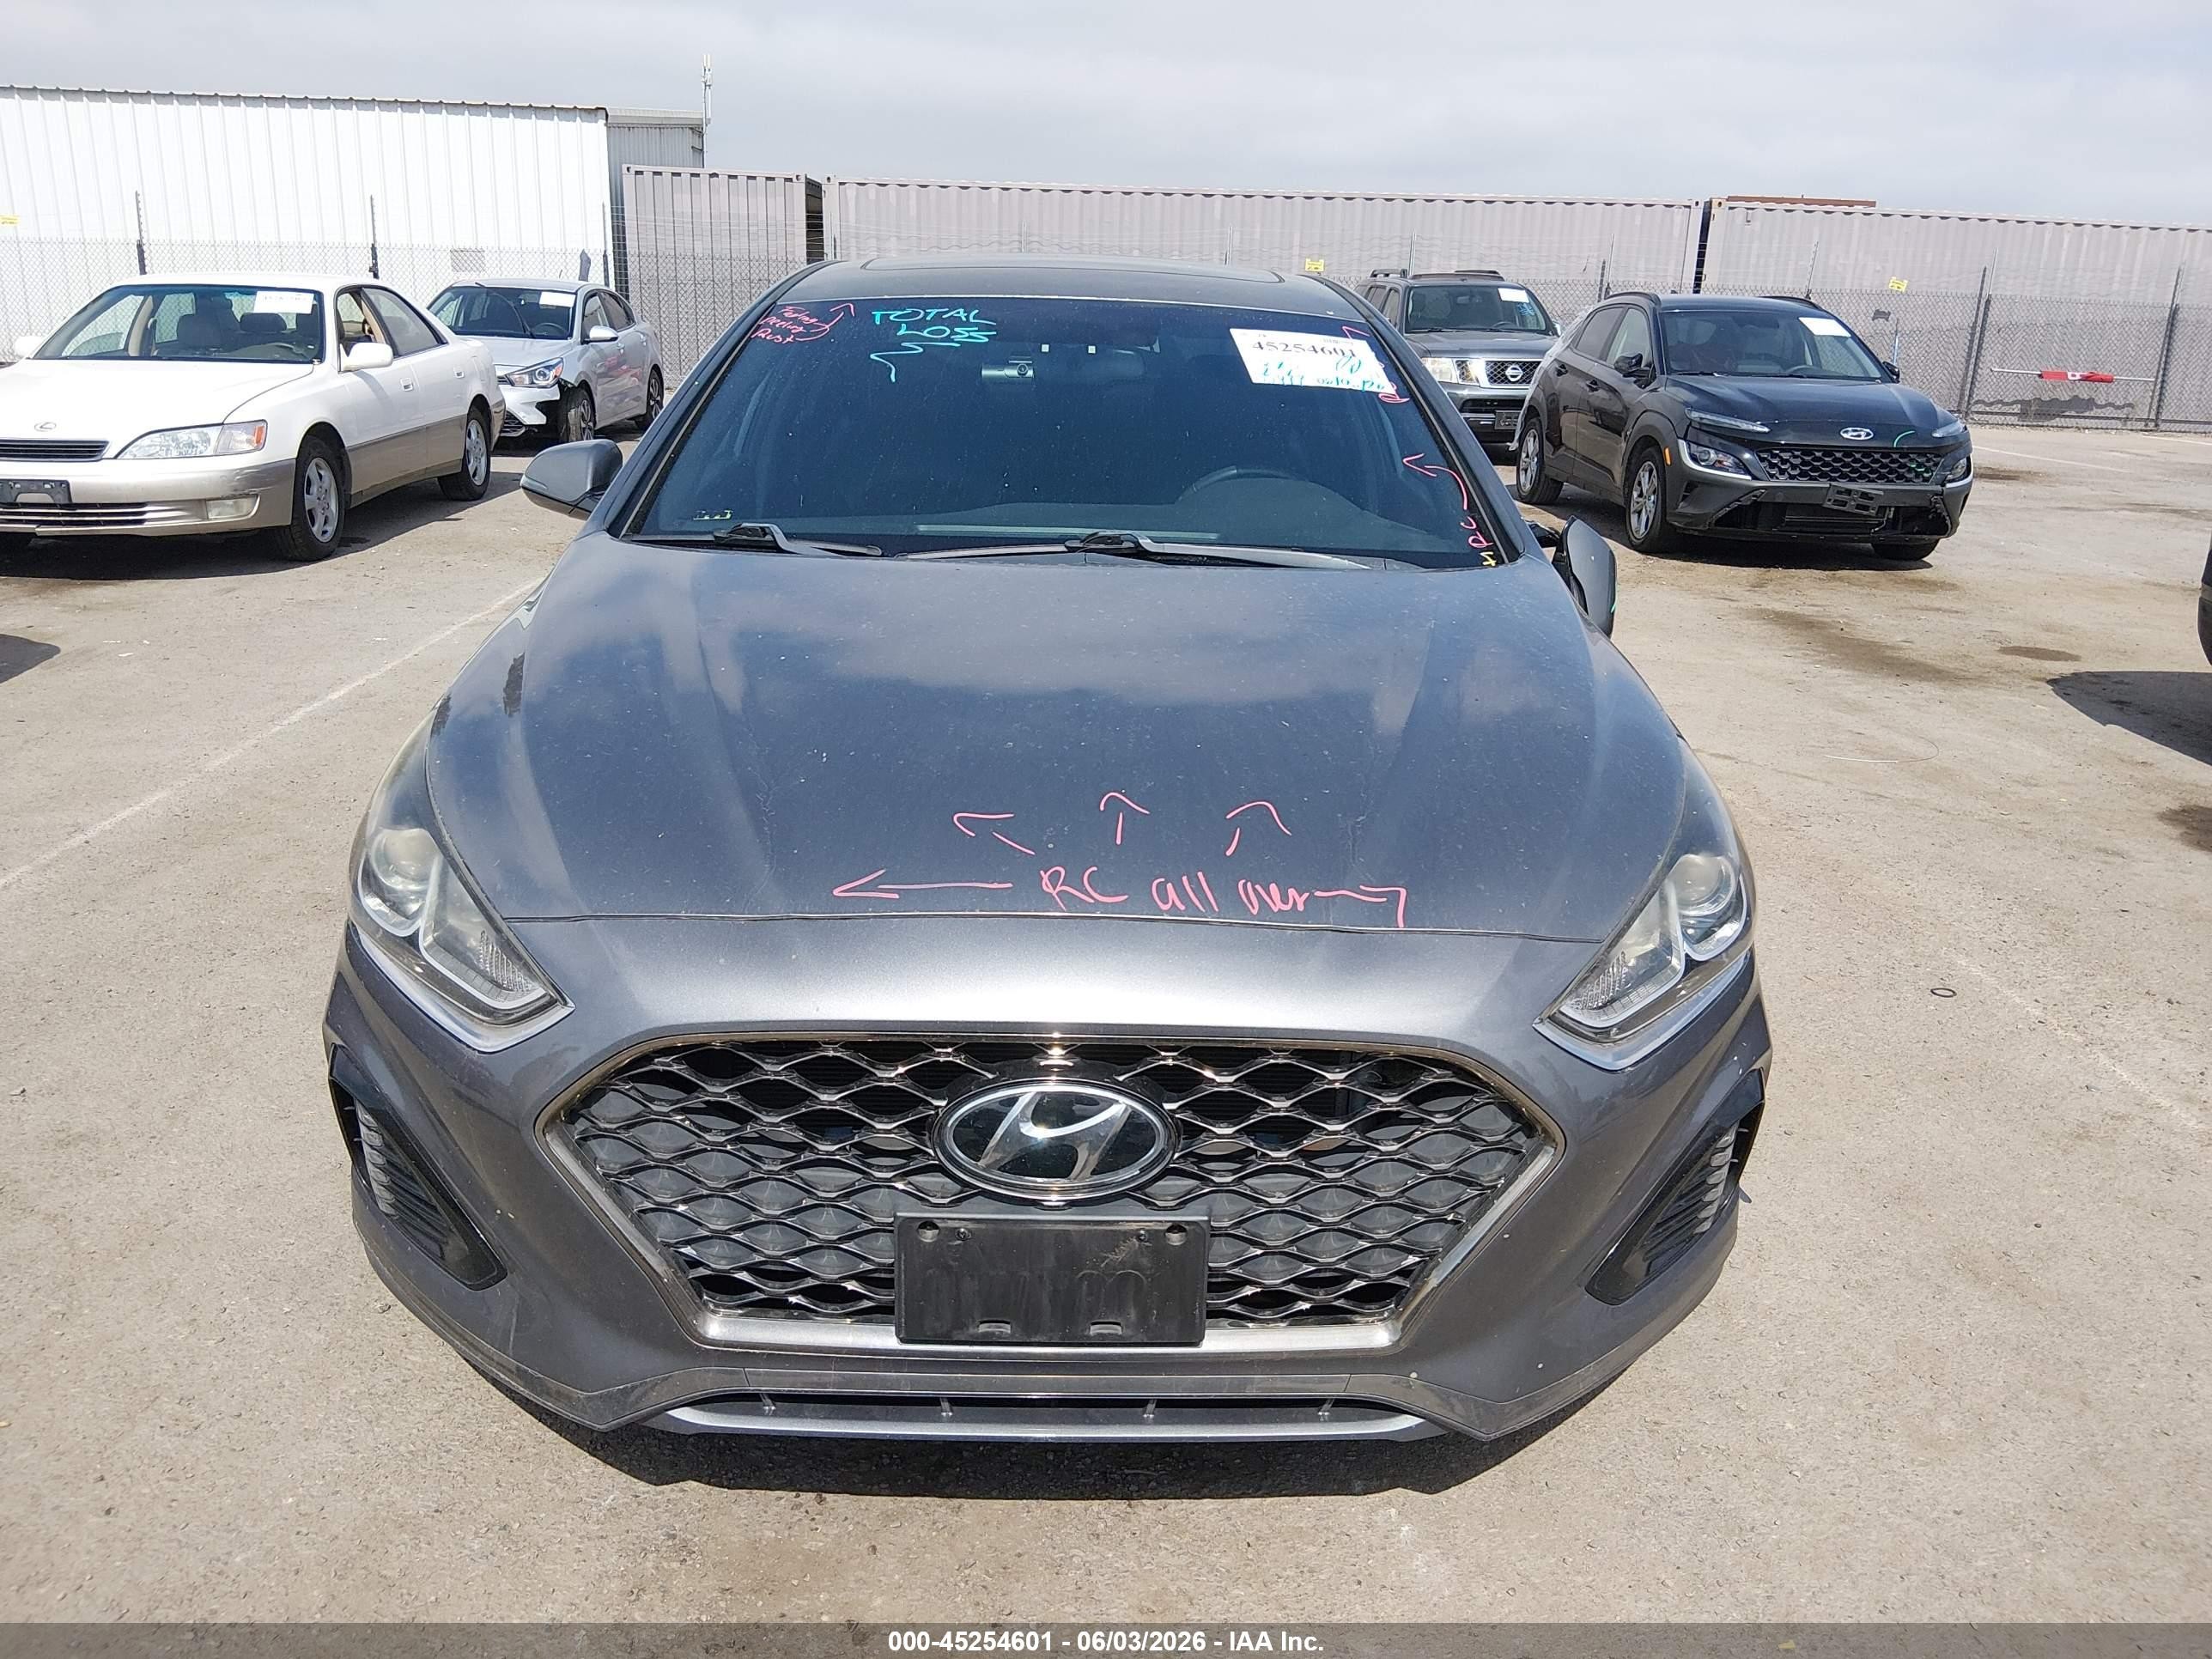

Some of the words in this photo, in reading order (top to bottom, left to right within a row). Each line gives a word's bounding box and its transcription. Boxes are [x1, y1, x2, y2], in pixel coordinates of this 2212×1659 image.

[872, 308, 997, 325] TOTAL
[896, 324, 997, 343] LOSS
[1040, 866, 1128, 912] RC
[1152, 872, 1219, 912] all
